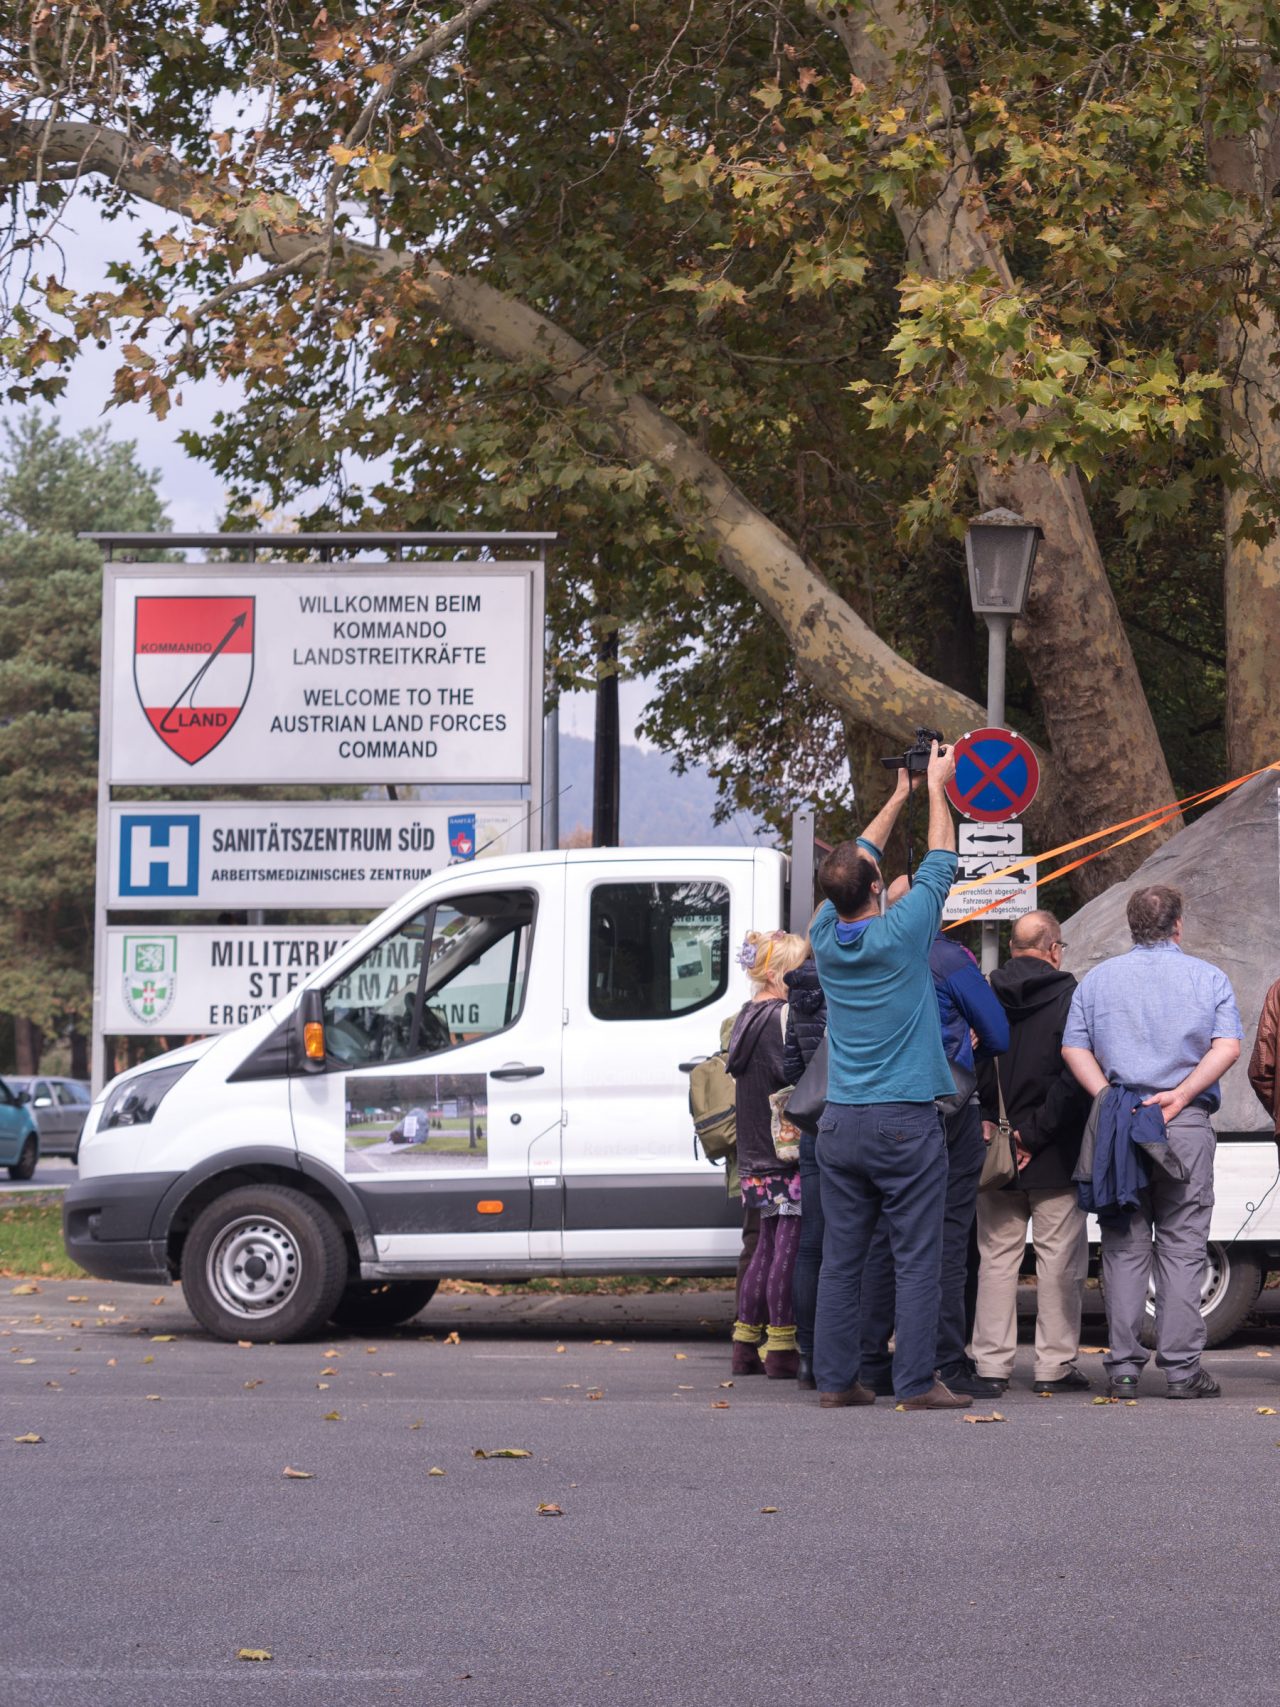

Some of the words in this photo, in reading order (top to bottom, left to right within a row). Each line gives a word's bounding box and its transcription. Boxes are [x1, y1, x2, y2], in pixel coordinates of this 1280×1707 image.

[300, 596, 429, 612] WILLKOMMEN
[435, 596, 481, 612] BEIM
[334, 621, 446, 638] KOMMANDO
[141, 642, 212, 653] KOMMANDO
[293, 644, 486, 665] LANDSTREITKRÄFTE
[304, 689, 400, 705] WELCOME
[407, 689, 431, 705] TO
[438, 689, 473, 705] THE
[178, 713, 227, 727] LAND
[270, 715, 366, 732] AUSTRIAN
[373, 715, 423, 731] LAND
[429, 714, 506, 731] FORCES
[339, 741, 437, 758] COMMAND
[212, 823, 391, 852] SANITÄTSZENTRUM
[398, 822, 435, 851] SÜD
[130, 826, 189, 887] H
[212, 869, 365, 882] ARBEITSMEDIZINISCHES
[370, 869, 432, 881] ZENTRUM
